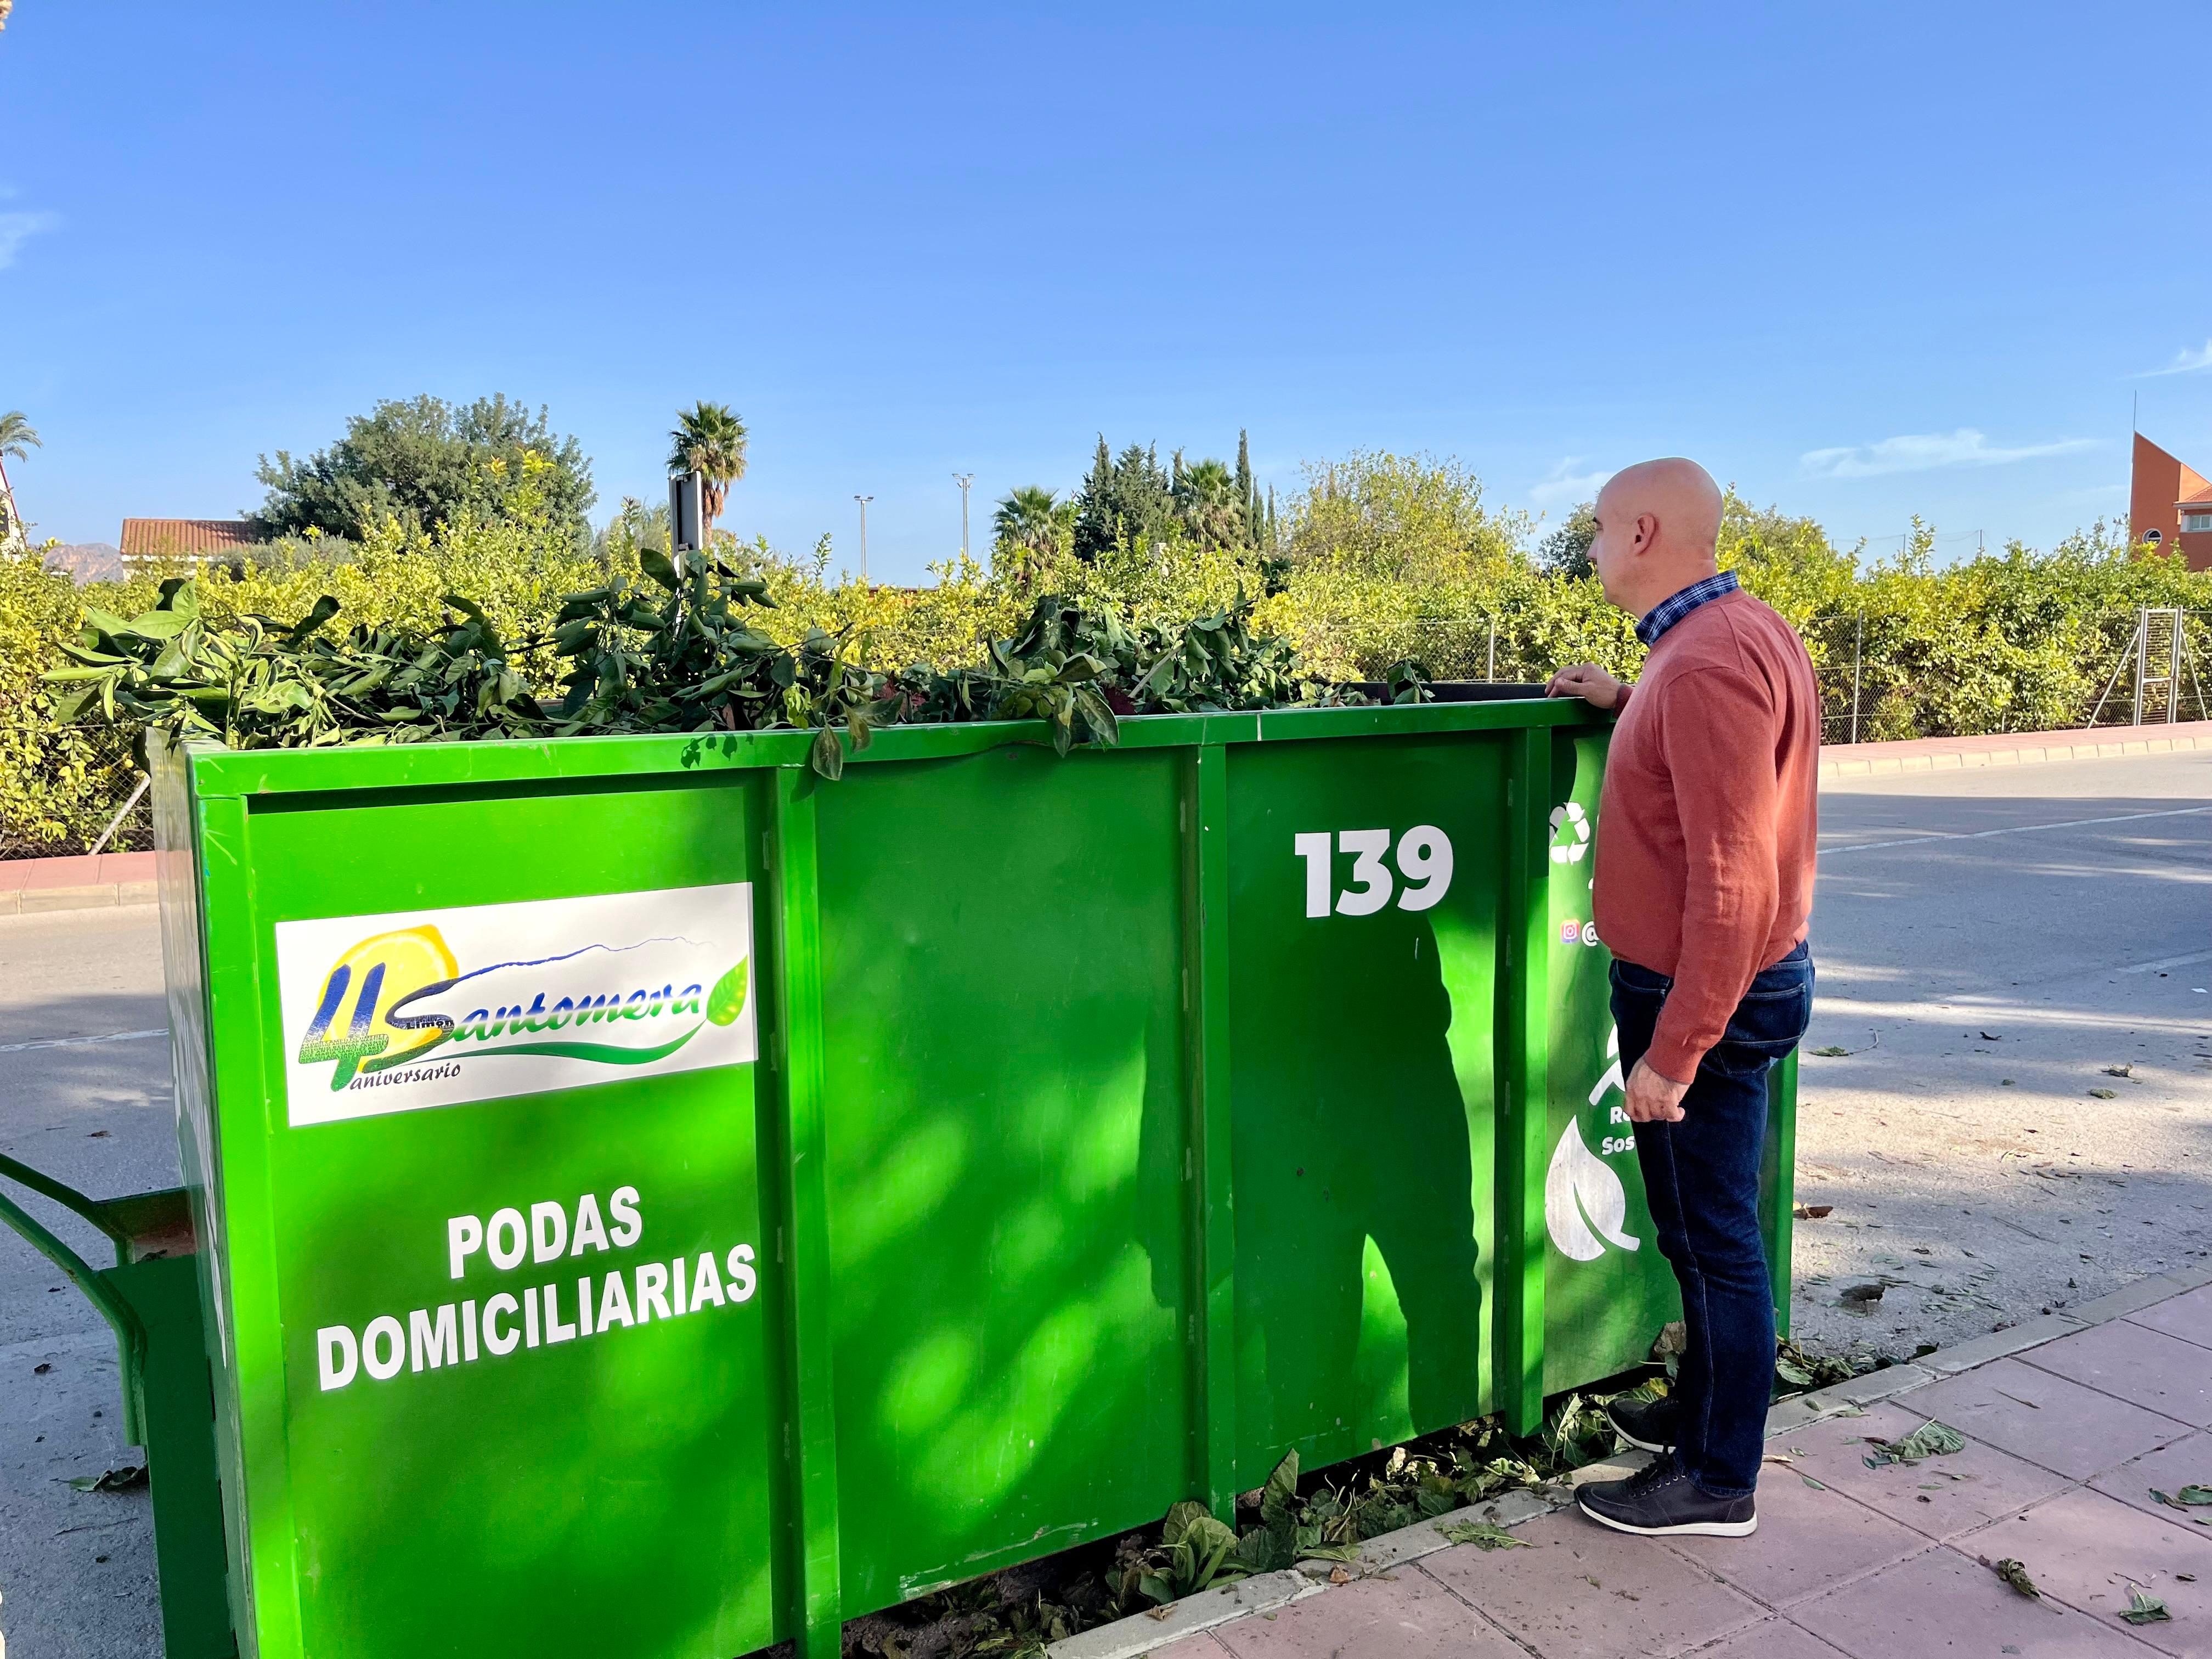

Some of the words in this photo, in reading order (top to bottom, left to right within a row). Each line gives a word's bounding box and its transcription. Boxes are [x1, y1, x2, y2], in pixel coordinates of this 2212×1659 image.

[1295, 825, 1453, 918] 139
[362, 978, 702, 1074] Santomera
[349, 1062, 461, 1090] aniversario
[448, 1186, 643, 1279] PODAS
[317, 1243, 757, 1391] DOMICILIARIAS
